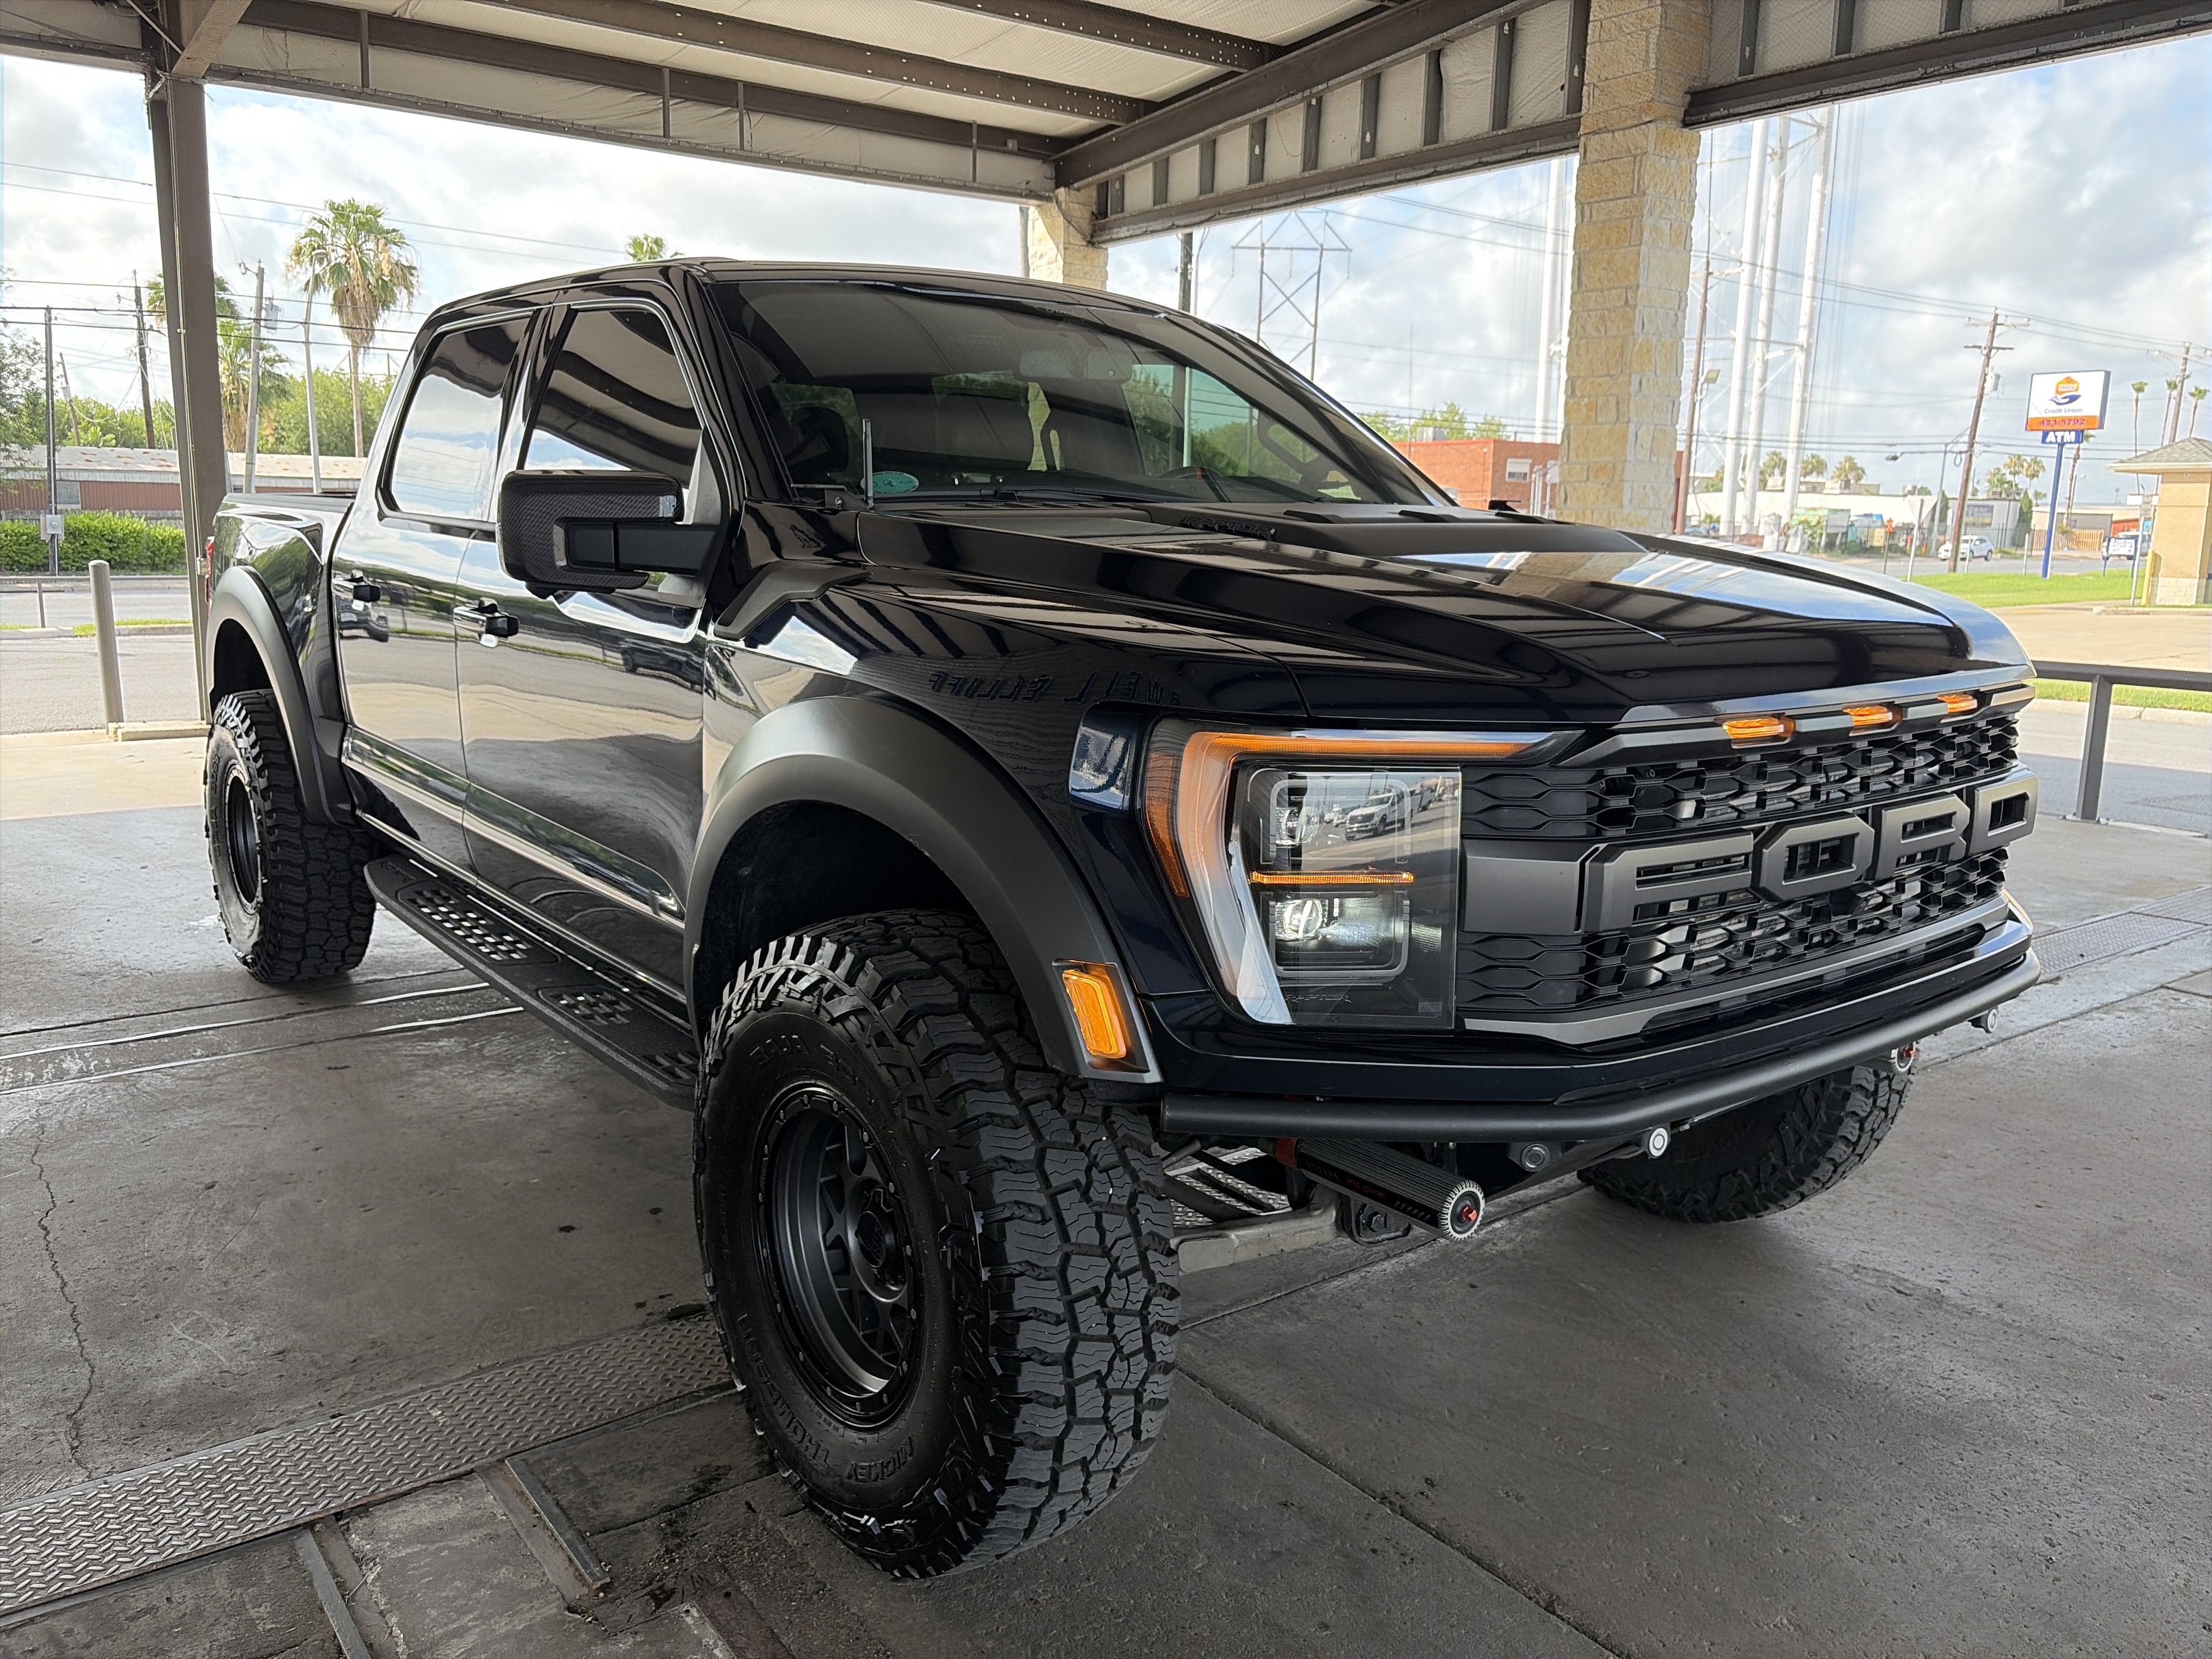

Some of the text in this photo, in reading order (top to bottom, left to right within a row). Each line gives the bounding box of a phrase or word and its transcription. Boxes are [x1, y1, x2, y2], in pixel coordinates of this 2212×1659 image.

[2045, 431, 2076, 443] ATM
[1180, 515, 1276, 542] RAPTOR
[1583, 774, 2039, 936] FORD
[1285, 994, 1352, 1004] RAPTOR
[847, 1436, 915, 1483] MICKEY
